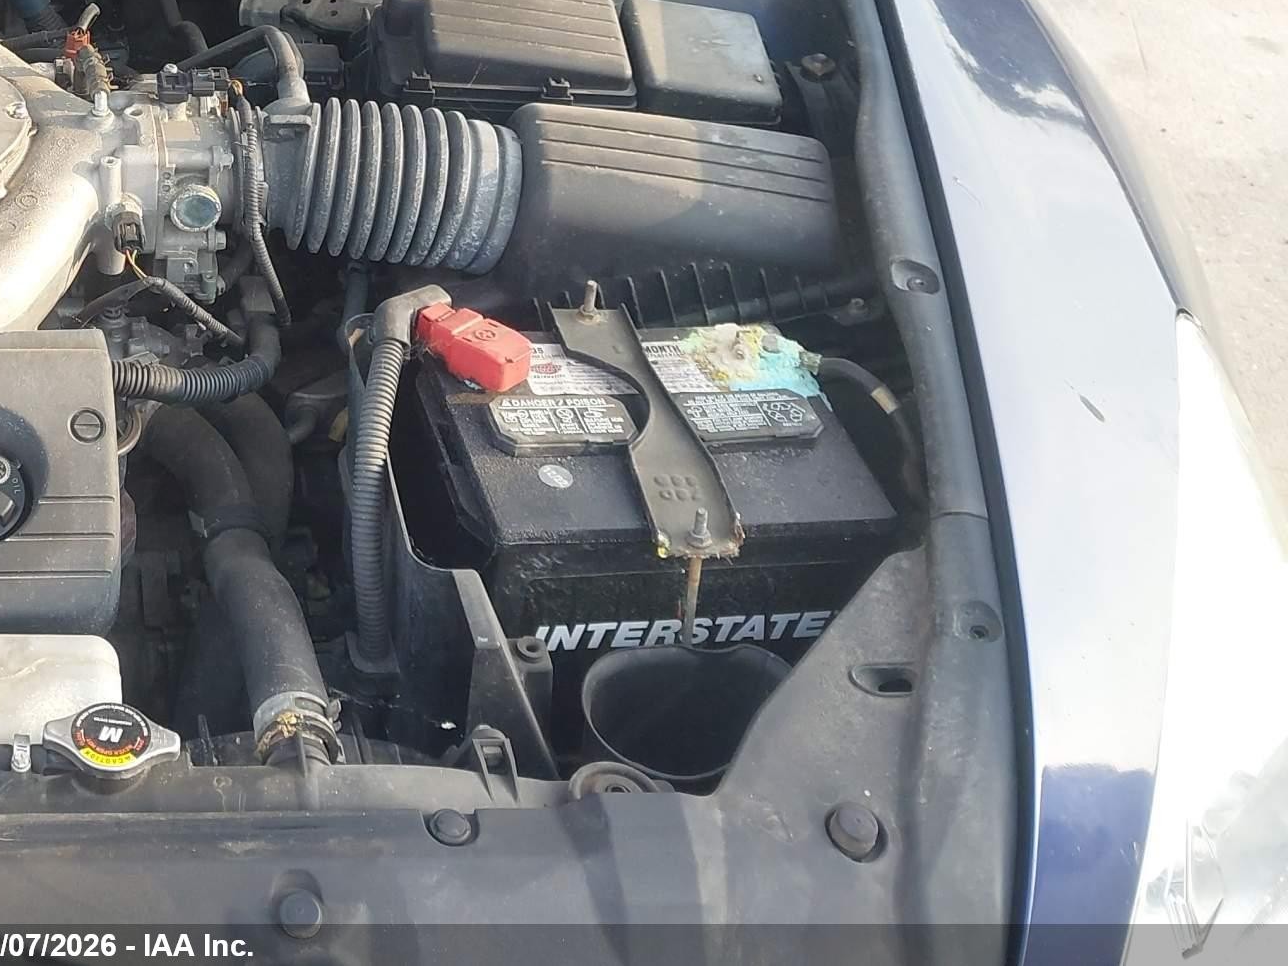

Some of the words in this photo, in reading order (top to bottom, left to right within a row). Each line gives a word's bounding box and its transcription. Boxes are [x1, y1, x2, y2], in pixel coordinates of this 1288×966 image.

[512, 398, 556, 407] DANGER
[566, 397, 607, 406] POISON
[534, 610, 832, 652] INTERSTATE
[85, 751, 124, 764] CAUTION
